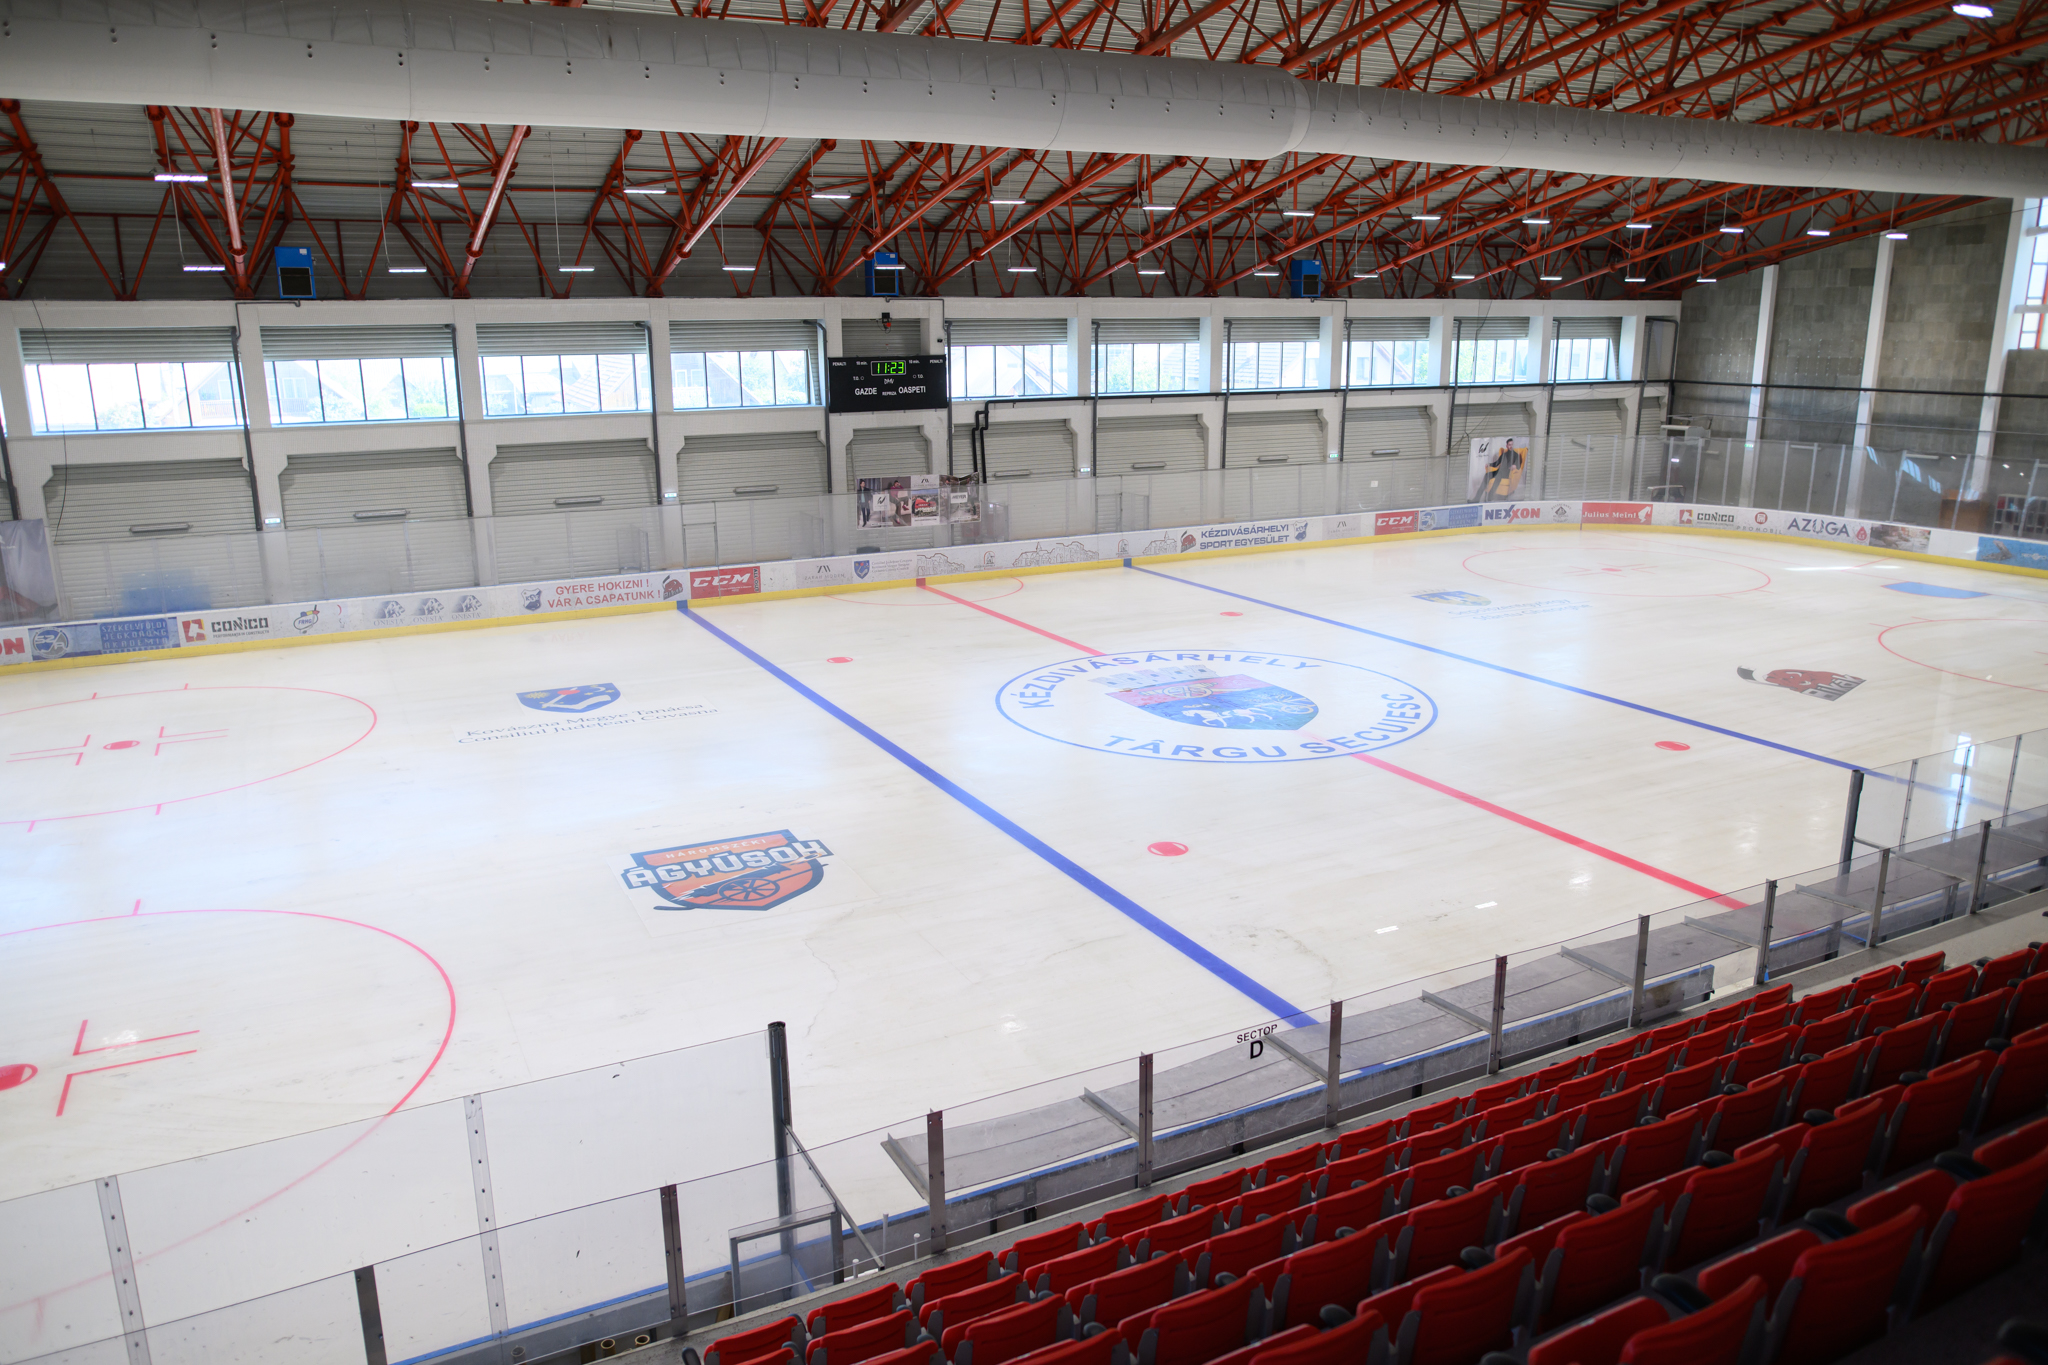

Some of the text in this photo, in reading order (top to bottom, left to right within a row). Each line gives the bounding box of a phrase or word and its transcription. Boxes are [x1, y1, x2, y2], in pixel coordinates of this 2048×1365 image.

[877, 361, 905, 374] 11:23
[854, 387, 878, 396] GAZDE
[1376, 515, 1413, 526] CCM
[1484, 504, 1541, 524] NEXXON
[1582, 510, 1637, 519] Julius Meinl
[1201, 524, 1289, 538] KÉZDIVÁSÁRHELYI
[1787, 517, 1851, 538] AZUGA
[1199, 539, 1233, 550] SPORT
[1234, 534, 1290, 547] EGYESÜLET
[555, 583, 595, 596] GYERE
[599, 579, 643, 591] HOKIZNI
[692, 573, 751, 588] CCM
[547, 596, 572, 609] VÁR
[575, 595, 583, 606] A
[585, 590, 655, 605] CSAPATUNK
[1018, 652, 1322, 709] KÉZDIVÁSÁRHELY
[458, 728, 547, 744] Consiliul
[641, 708, 719, 721] Covasna
[467, 703, 704, 737] Kovászna Megye Tanácsa
[1103, 692, 1423, 760] TÂRGU SECUIESC
[666, 839, 767, 859] HÁROMSZÉKI
[626, 840, 828, 889] ÁGYÚSOK
[1249, 1039, 1264, 1060] D
